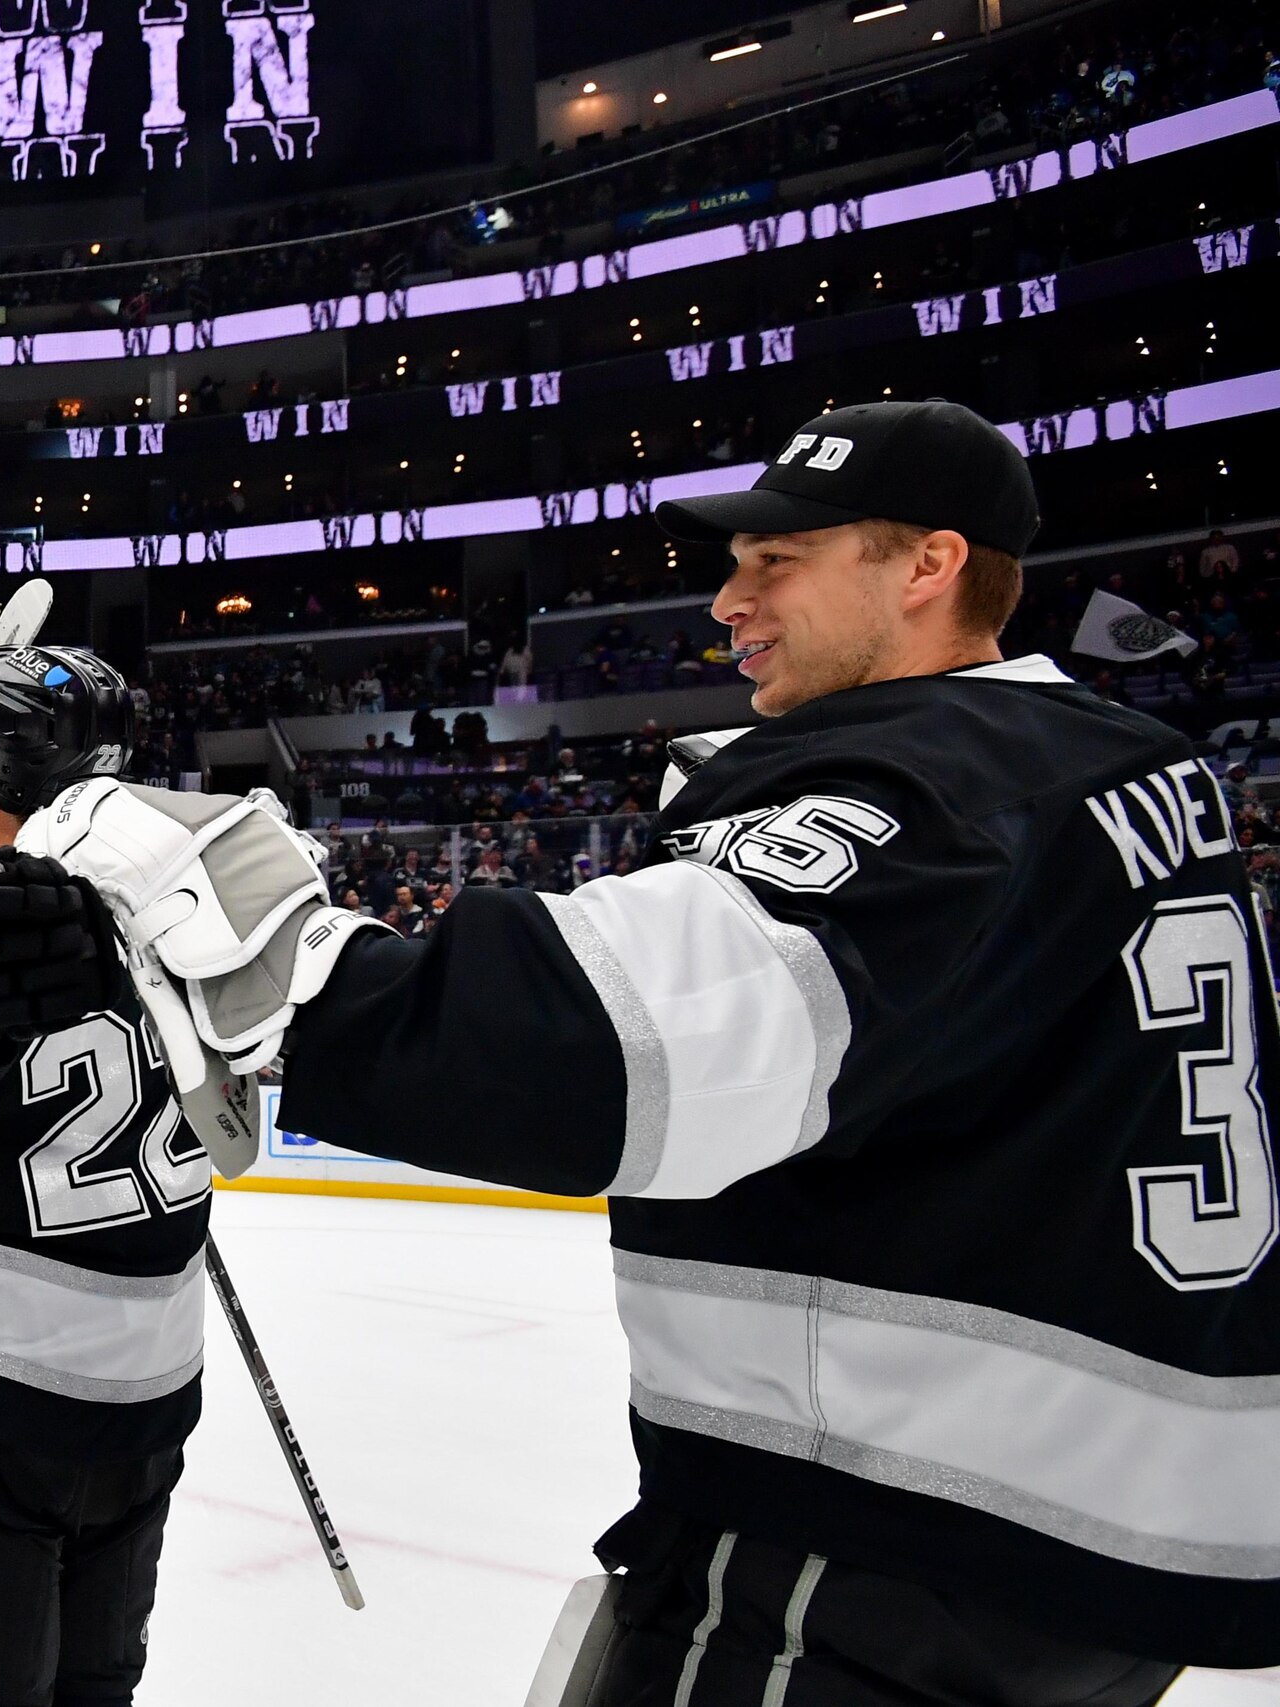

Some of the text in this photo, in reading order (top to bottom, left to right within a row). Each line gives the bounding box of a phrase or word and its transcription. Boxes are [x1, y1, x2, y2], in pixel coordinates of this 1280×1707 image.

[984, 128, 1130, 201] WIN
[740, 195, 865, 254] WIN
[519, 247, 630, 301] WIN
[306, 286, 409, 332] WIN
[912, 274, 1057, 337] WIN
[120, 317, 215, 358] WIN
[665, 325, 795, 382] WIN
[445, 371, 562, 417] WIN
[66, 423, 165, 459] WIN
[243, 399, 351, 443] WIN
[1019, 392, 1169, 456] WIN
[776, 433, 854, 472] FD
[537, 479, 652, 528] WIN
[130, 529, 227, 567] WIN
[320, 507, 424, 550] WIN
[6, 657, 40, 680] CALIFORNIA
[11, 645, 50, 674] blue
[91, 744, 122, 774] 22
[340, 782, 370, 798] 108
[1121, 893, 1280, 1292] 3
